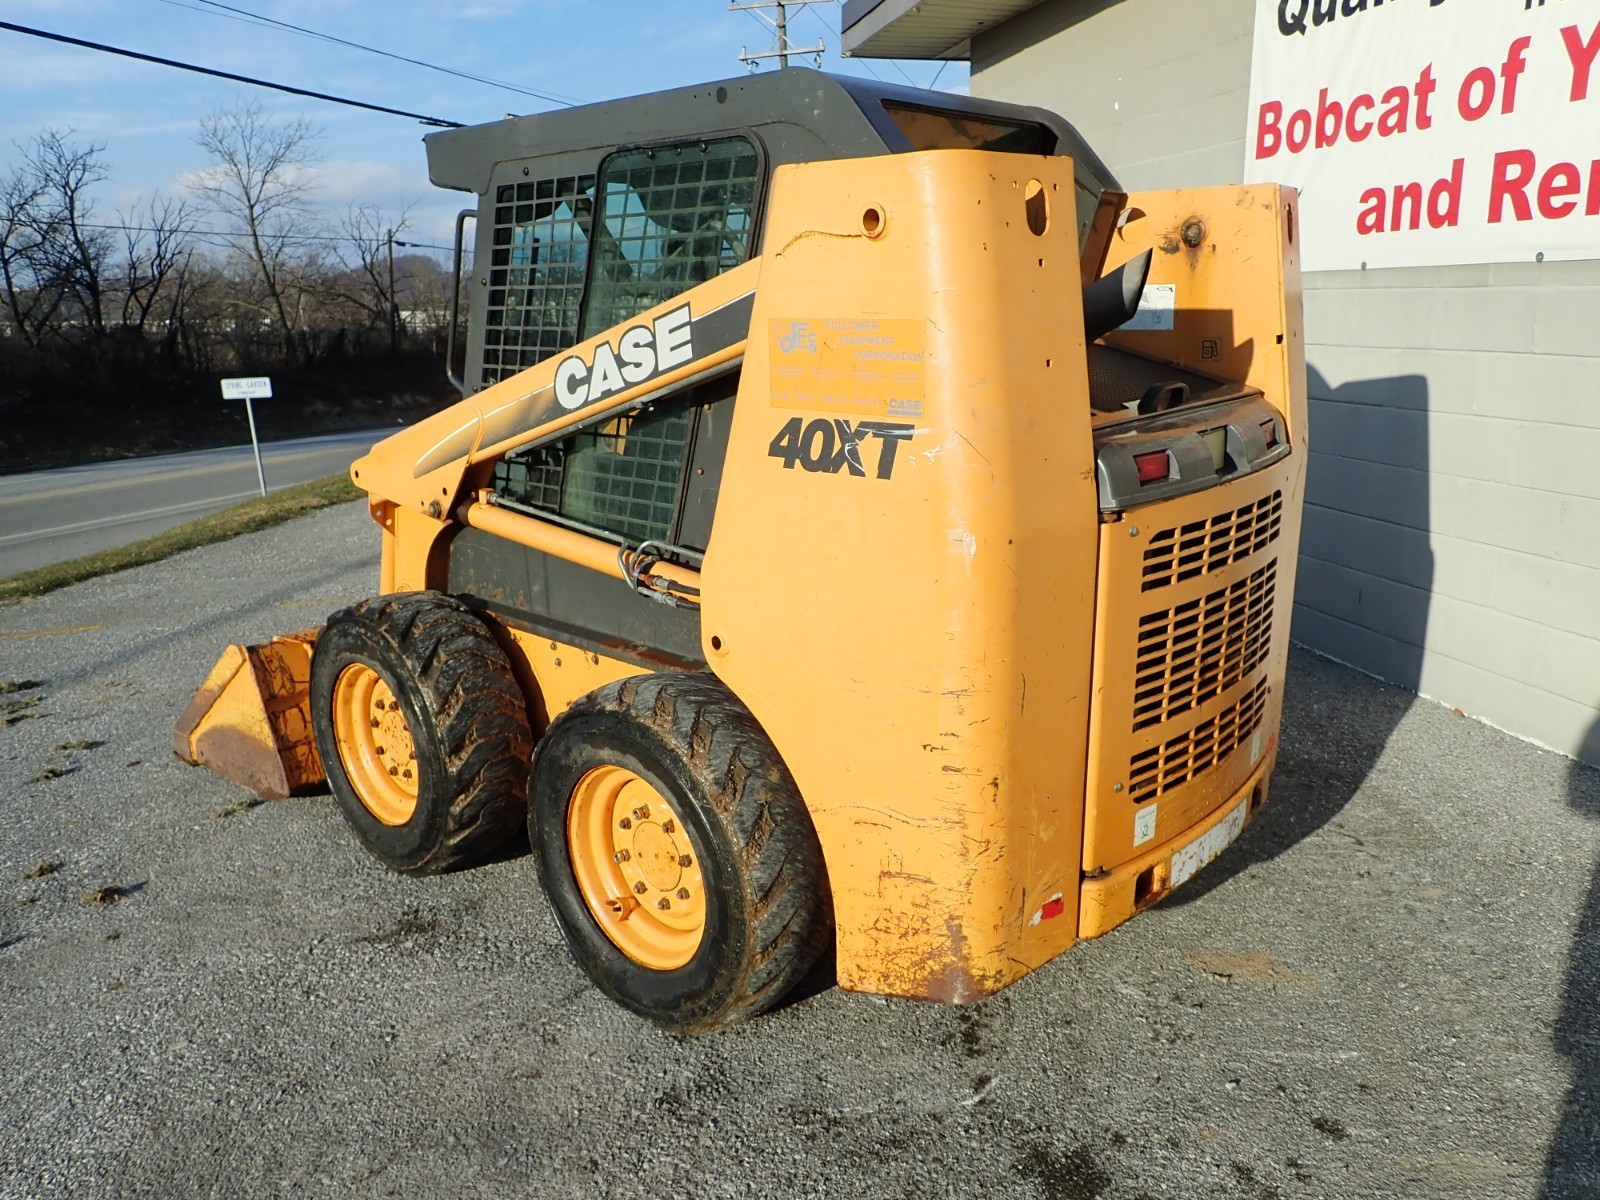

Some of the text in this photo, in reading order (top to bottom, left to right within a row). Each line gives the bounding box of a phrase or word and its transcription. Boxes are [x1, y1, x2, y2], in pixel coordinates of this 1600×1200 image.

[1255, 62, 1437, 160] Bobcat
[1457, 35, 1532, 122] of
[1356, 158, 1465, 235] and
[554, 303, 694, 410] CASE
[853, 350, 924, 362] CORPORATION
[888, 398, 922, 411] CASE
[767, 416, 916, 480] 40XT
